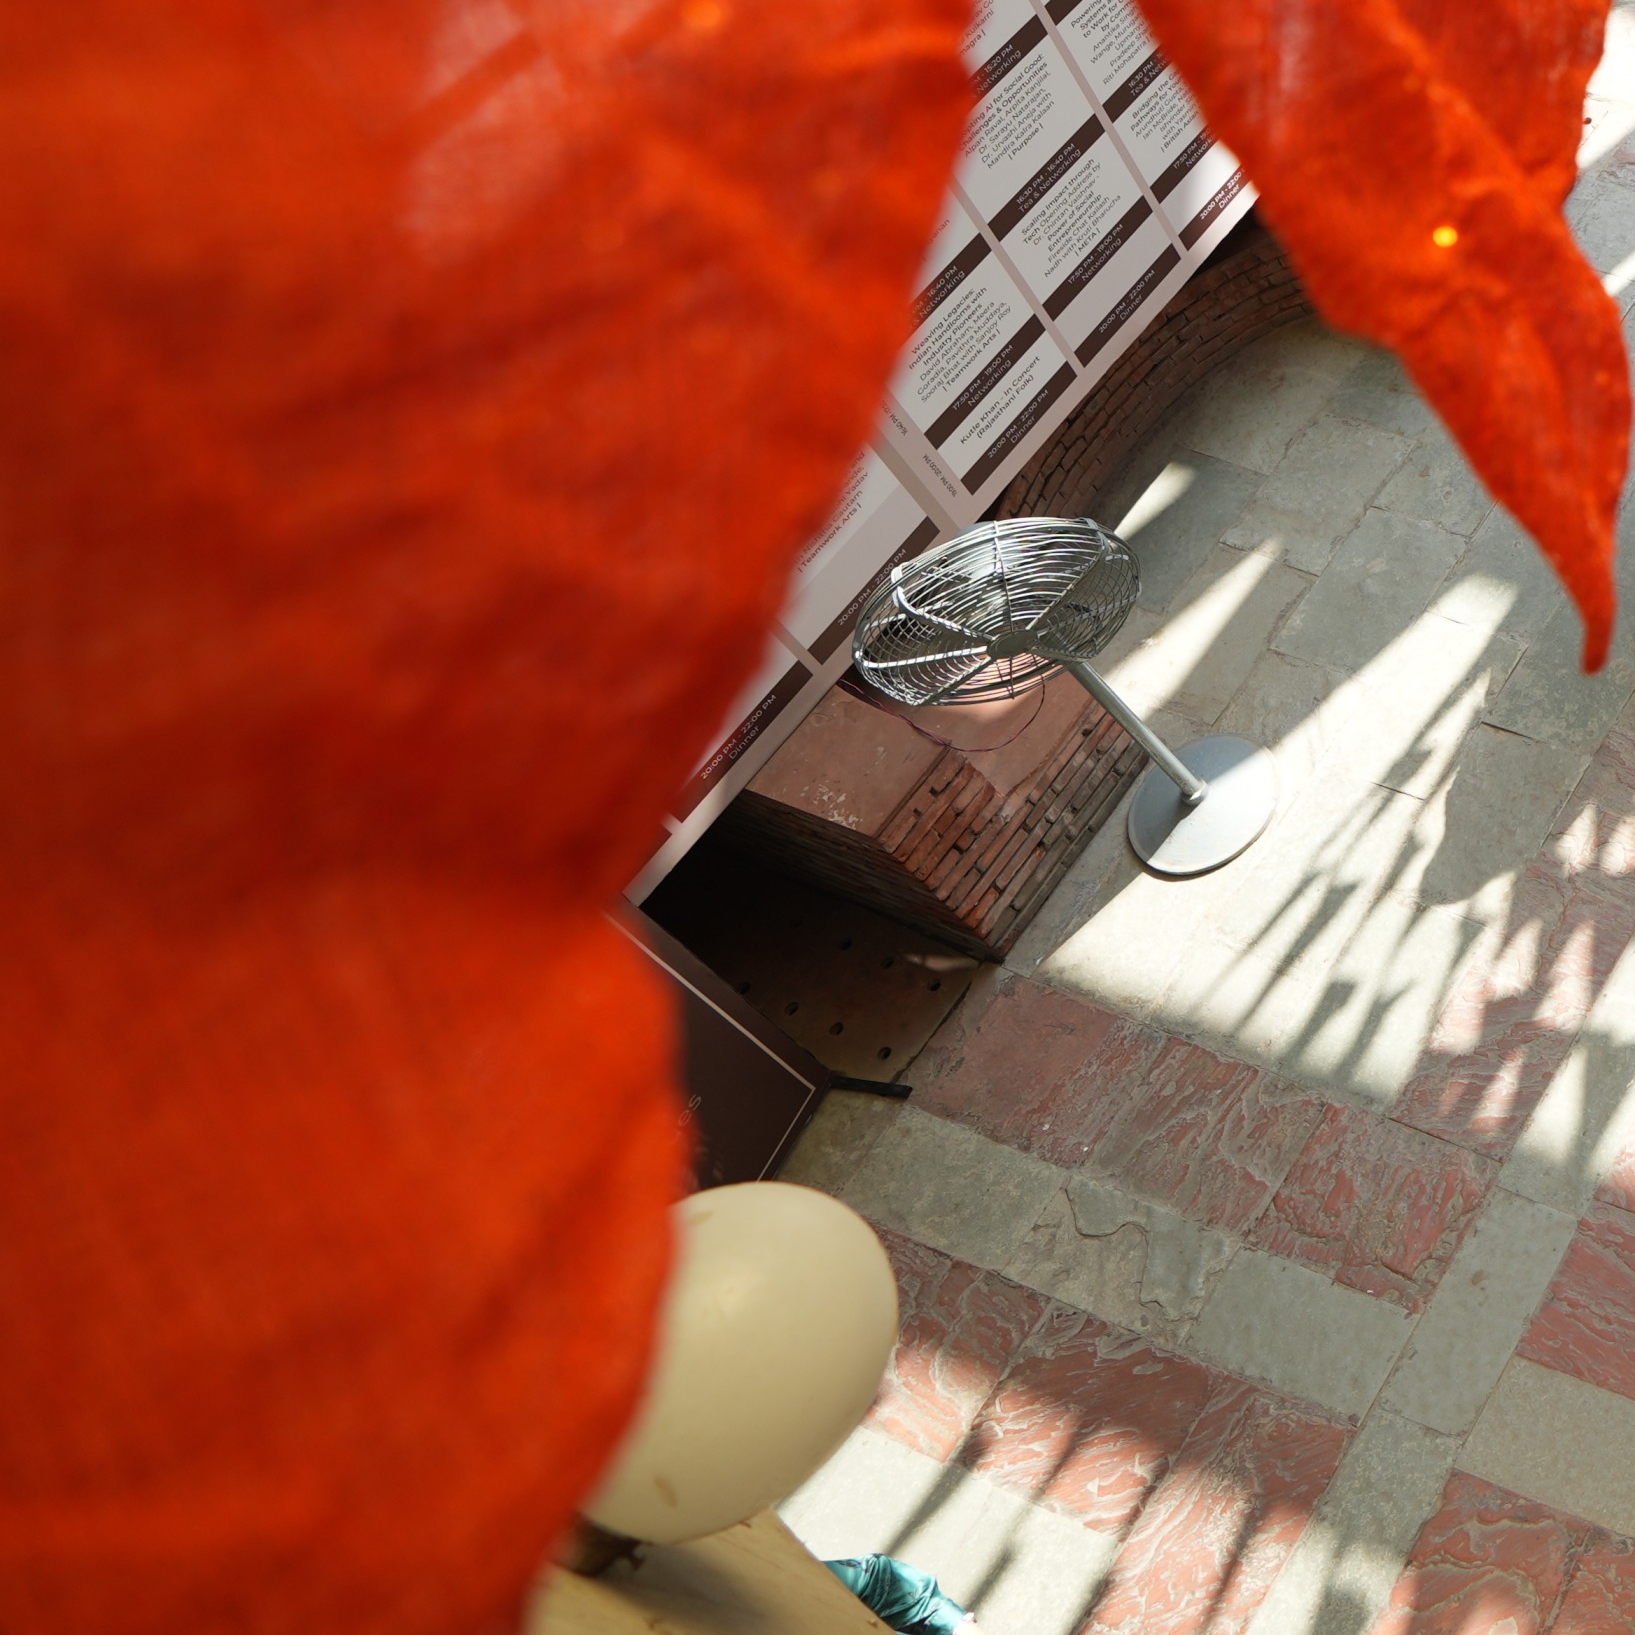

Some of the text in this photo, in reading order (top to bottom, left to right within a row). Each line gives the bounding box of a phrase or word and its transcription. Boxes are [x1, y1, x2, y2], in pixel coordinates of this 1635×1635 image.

[1080, 3, 1106, 30] Systems
[1090, 3, 1117, 29] Work for
[977, 50, 1020, 90] Networking
[993, 72, 1024, 104] for Social
[1001, 62, 1047, 107] Opportunities
[1130, 83, 1143, 95] Tea
[1036, 92, 1051, 107] with
[987, 140, 1014, 168] Mandira
[1011, 127, 1039, 155] Purpose
[1016, 154, 1063, 203] 16:30 16:40
[1018, 149, 1081, 211] Tea Networking
[1021, 159, 1094, 234] Scaling Impact through
[1218, 184, 1238, 208] Dinner
[1023, 172, 1092, 243] Tech Opening Address
[1043, 178, 1095, 234] Chintan Vaishnav
[1047, 190, 1094, 241] Power Social
[1047, 196, 1109, 262] Fireside Chat Kailash
[1048, 194, 1101, 251] Entrepreneurship
[1044, 195, 1120, 277] Nadh with Kruti Bharucha
[1078, 232, 1096, 252] META
[1068, 267, 1083, 283] 17:50
[1081, 239, 1123, 282] Networking
[922, 270, 965, 318] Networking
[931, 287, 986, 345] Handlooms with
[1099, 281, 1144, 332] 20:00 22:00
[1119, 295, 1141, 320] Dinner
[911, 321, 943, 353] Weaving
[919, 301, 994, 381] David Meera
[923, 304, 982, 365] Industry Pioneers
[943, 306, 1010, 378] Bhat with Sanjoy Roy
[945, 335, 974, 364] Pavithra
[946, 333, 996, 385] Teamwork Arts
[967, 359, 1010, 405] Networking
[952, 356, 1002, 410] 17:50 19:00
[960, 356, 1039, 444] Kutle Khan Concert
[976, 394, 1015, 438] (Rajasthani
[988, 401, 1037, 457] 20:00 22:00
[1010, 416, 1034, 443] Dinner
[838, 602, 858, 625] 20:00
[701, 709, 762, 778] 20:00 22:00
[728, 725, 758, 758] Dinner
